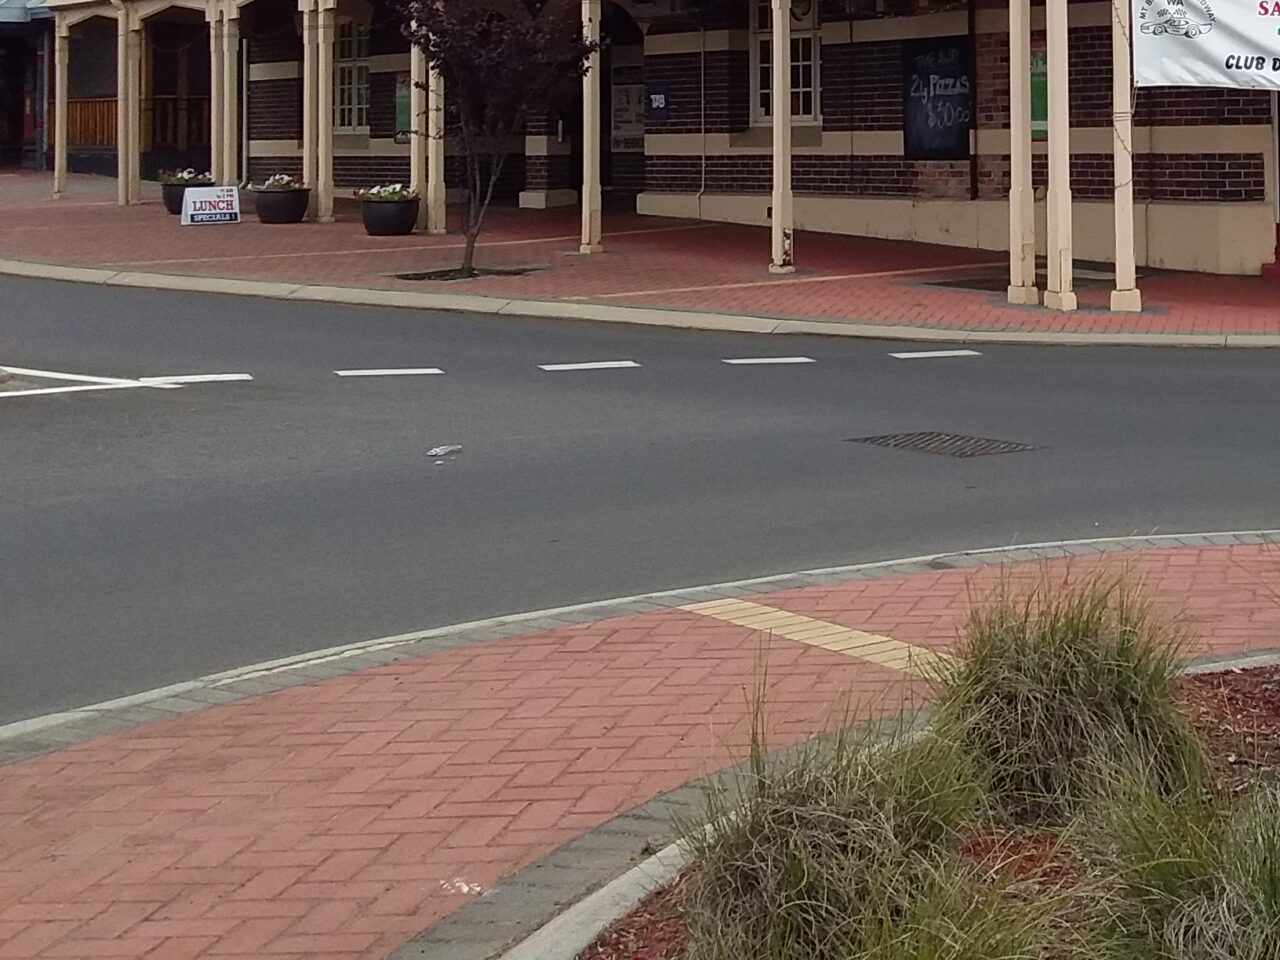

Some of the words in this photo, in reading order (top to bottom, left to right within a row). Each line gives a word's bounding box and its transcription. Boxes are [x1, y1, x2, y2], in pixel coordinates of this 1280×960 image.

[1139, 6, 1149, 20] MT
[1225, 54, 1266, 71] CLUB
[650, 94, 666, 108] TAB
[192, 200, 234, 211] LUNCH
[193, 214, 230, 222] SPECIALS
